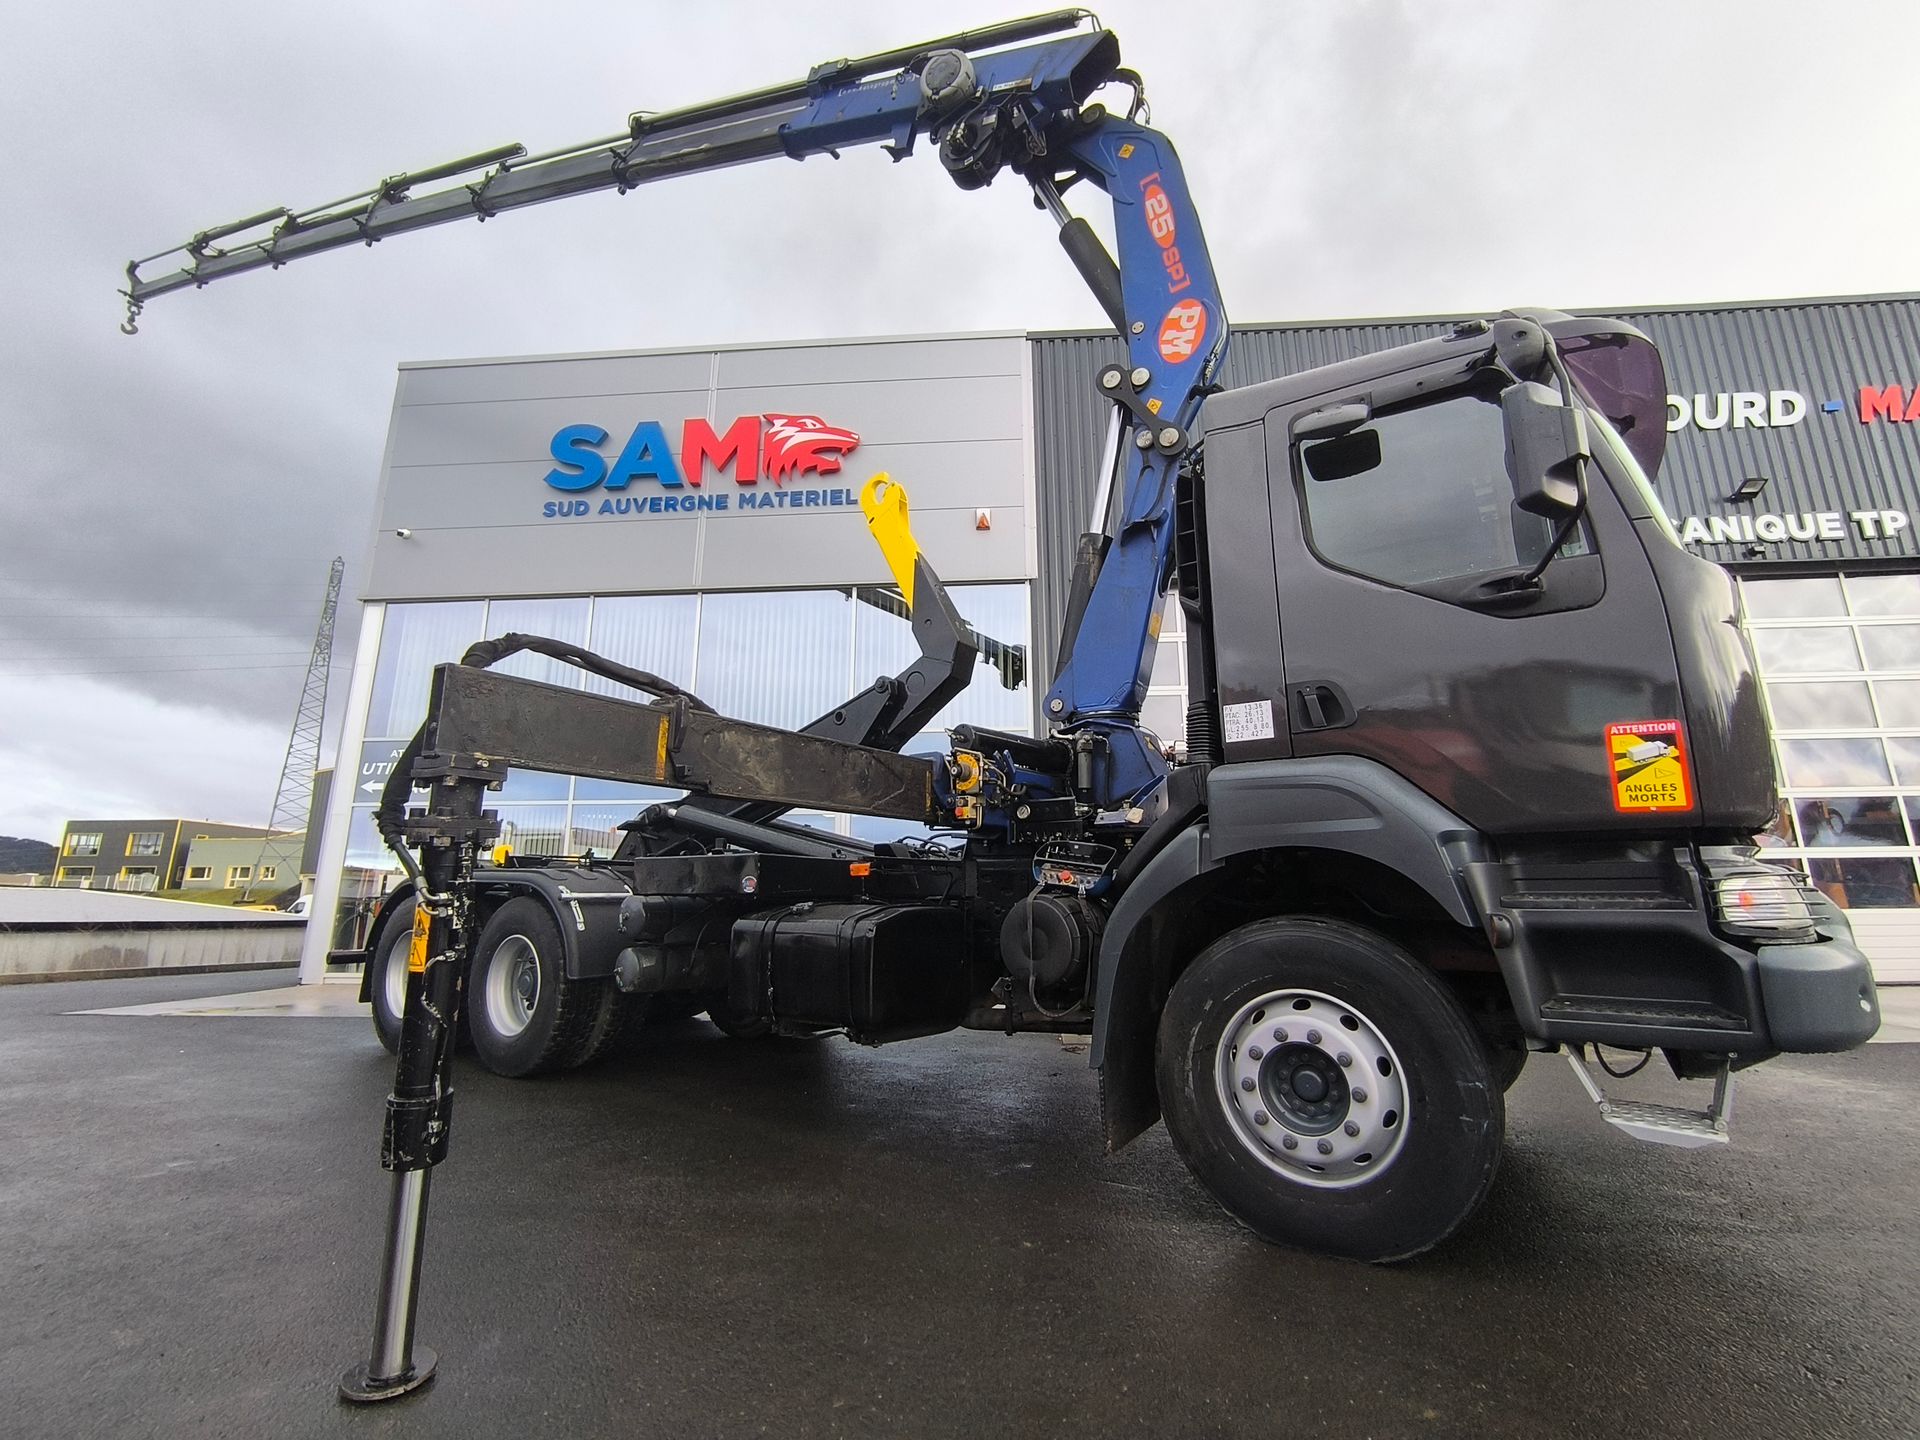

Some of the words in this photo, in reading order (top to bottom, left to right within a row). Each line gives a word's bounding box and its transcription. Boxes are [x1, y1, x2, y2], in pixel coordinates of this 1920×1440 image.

[1160, 306, 1202, 355] PM
[1666, 390, 1807, 432] OURD
[543, 416, 761, 492] SAM
[543, 501, 590, 518] SUD
[599, 494, 729, 515] AUVERGNE
[739, 488, 858, 509] MATERIEL
[1671, 512, 1845, 543] ANIQUE
[1852, 510, 1907, 539] TP
[1610, 723, 1676, 734] ATTENTION
[1625, 783, 1678, 792] ANGLES
[1629, 793, 1677, 802] MORTS
